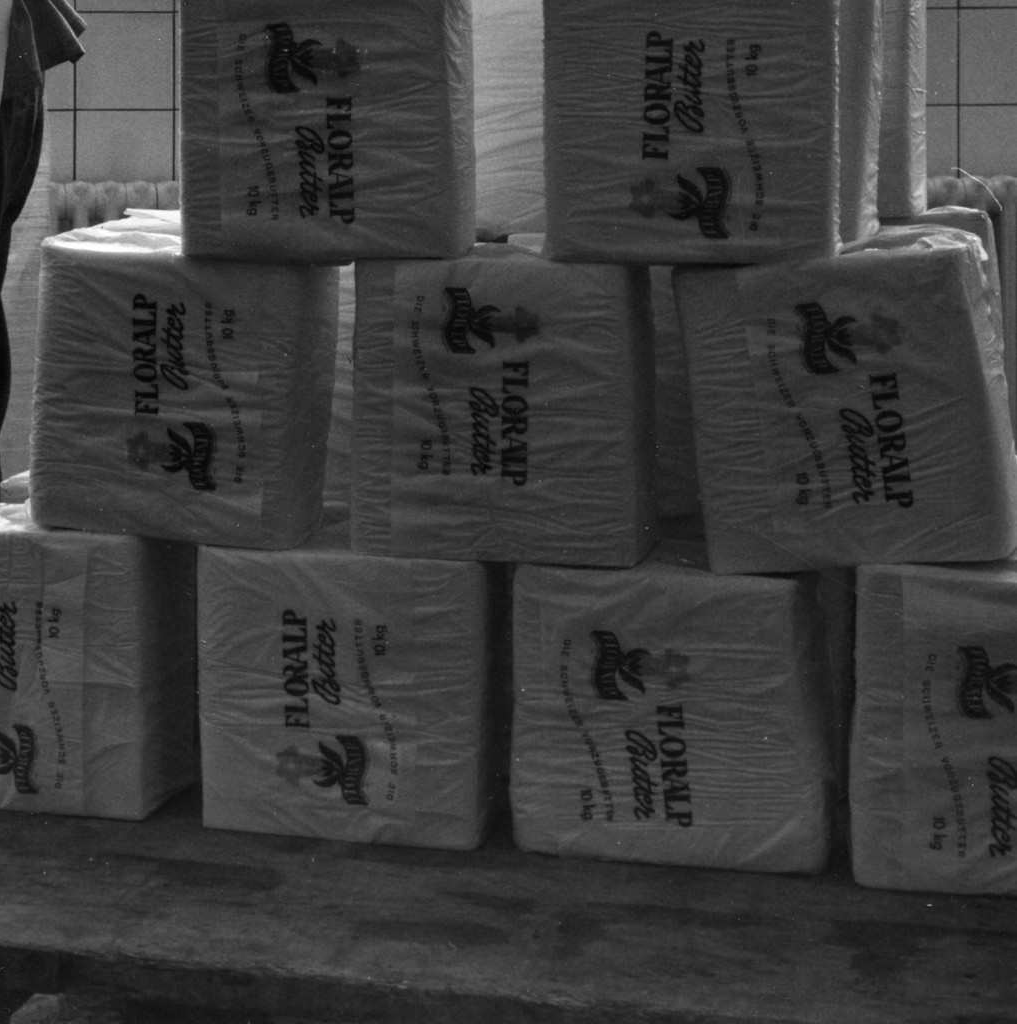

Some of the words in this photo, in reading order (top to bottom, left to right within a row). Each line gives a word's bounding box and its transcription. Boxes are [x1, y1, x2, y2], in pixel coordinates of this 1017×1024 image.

[237, 34, 246, 51] DIE
[744, 45, 761, 60] kg
[746, 65, 758, 76] 10
[234, 59, 255, 123] SCHWEIZER
[674, 38, 704, 133] Butter
[642, 31, 673, 160] FLORALP
[326, 96, 355, 224] FLORALP
[295, 126, 324, 219] Butter
[248, 186, 259, 197] 10
[247, 201, 261, 216] kg
[703, 173, 723, 235] FLORALP
[749, 213, 760, 231] DIE
[414, 296, 425, 313] DIE
[220, 309, 235, 324] kg
[450, 291, 469, 348] FLORLP
[222, 328, 233, 340] 10
[767, 318, 775, 336] DIE
[133, 294, 159, 415] FLORALP
[160, 302, 189, 390] Butter
[411, 320, 429, 380] SCHWEIZER
[767, 345, 795, 408] SCHWEIZER
[226, 397, 246, 458] SCHWEIZER
[469, 387, 499, 476] Butter
[501, 360, 529, 486] FLORALP
[421, 440, 432, 450] 10
[870, 373, 914, 508] FLORALP
[192, 427, 210, 487] FLORALP
[418, 454, 433, 470] kg
[839, 408, 876, 504] Butter
[234, 465, 244, 483] DIE
[797, 473, 809, 484] 10
[796, 488, 811, 505] kg
[47, 607, 62, 622] kg
[49, 627, 59, 638] 10
[372, 625, 387, 640] kg
[374, 645, 385, 656] 10
[562, 640, 571, 656] DIE
[282, 609, 310, 728] FLORALP
[312, 618, 340, 705] Butter
[926, 654, 937, 672] DIE
[560, 665, 584, 727] SCHWEIZER
[922, 680, 942, 749] SCHWEIZER
[49, 701, 66, 765] SCHWEIZER
[16, 731, 31, 790] FLORALP
[656, 706, 692, 827] FLORALP
[54, 773, 63, 789] DIE
[625, 730, 658, 820] Butter
[386, 783, 396, 800] DIE
[580, 790, 592, 801] 10
[581, 804, 595, 820] kg
[987, 756, 1017, 858] Butter
[933, 816, 946, 830] 10
[930, 834, 947, 850] kg
